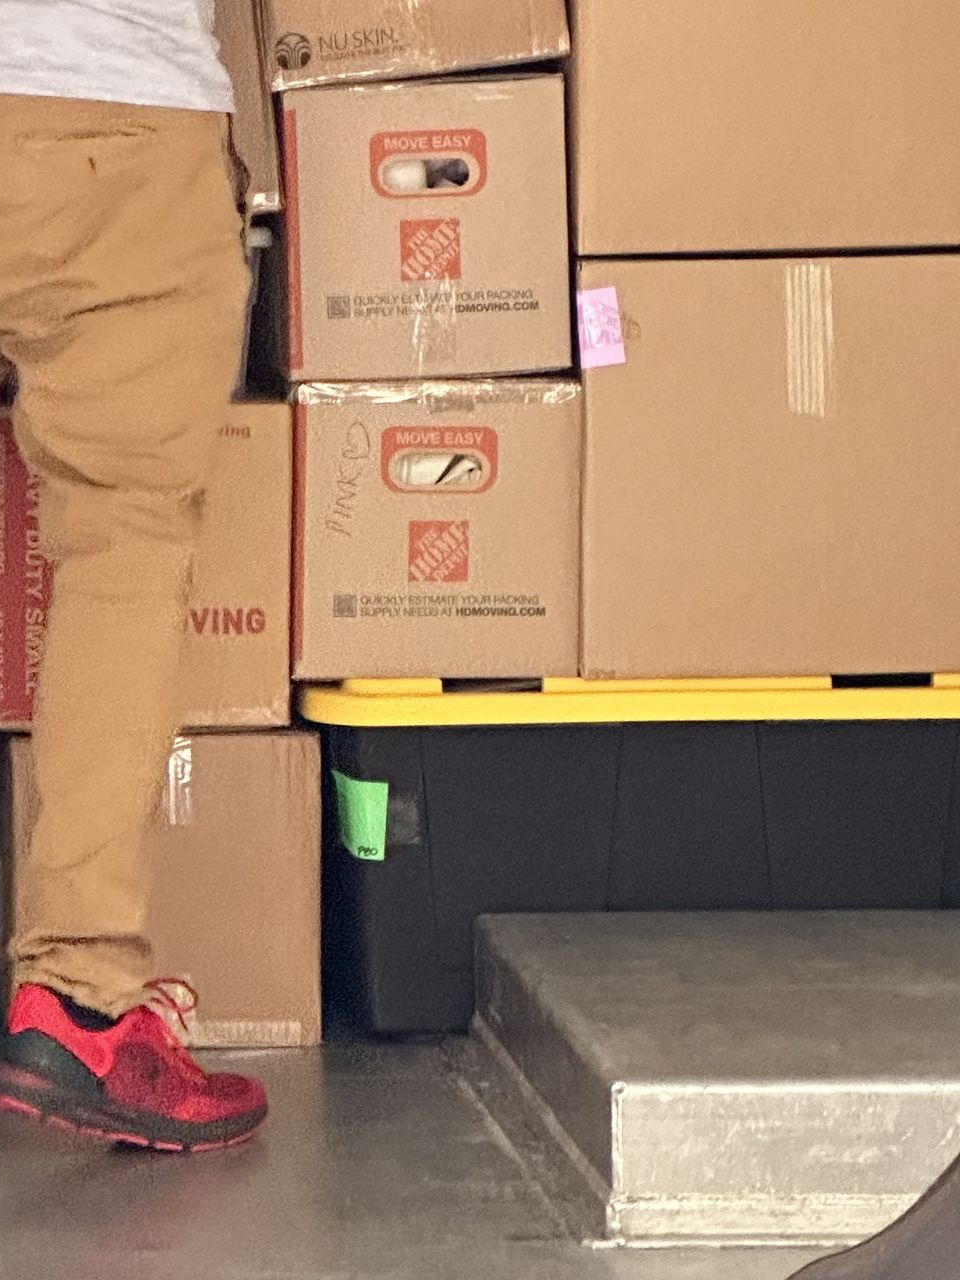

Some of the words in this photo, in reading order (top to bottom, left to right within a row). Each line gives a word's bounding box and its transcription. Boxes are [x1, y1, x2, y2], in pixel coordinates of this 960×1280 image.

[318, 33, 348, 53] NU
[384, 136, 429, 151] MOVE
[431, 134, 472, 149] EASY
[486, 289, 533, 300] PACKING
[396, 431, 440, 445] MOVE
[443, 431, 484, 445] EASY
[408, 595, 458, 606] ESTIMATE
[461, 595, 491, 606] YOUR
[494, 595, 539, 606] PACKING
[360, 606, 403, 617] SUPPLY
[404, 606, 438, 617] NEEDS
[441, 606, 453, 617] AT
[455, 606, 546, 617] HDMOVING.COM
[190, 606, 266, 635] VING
